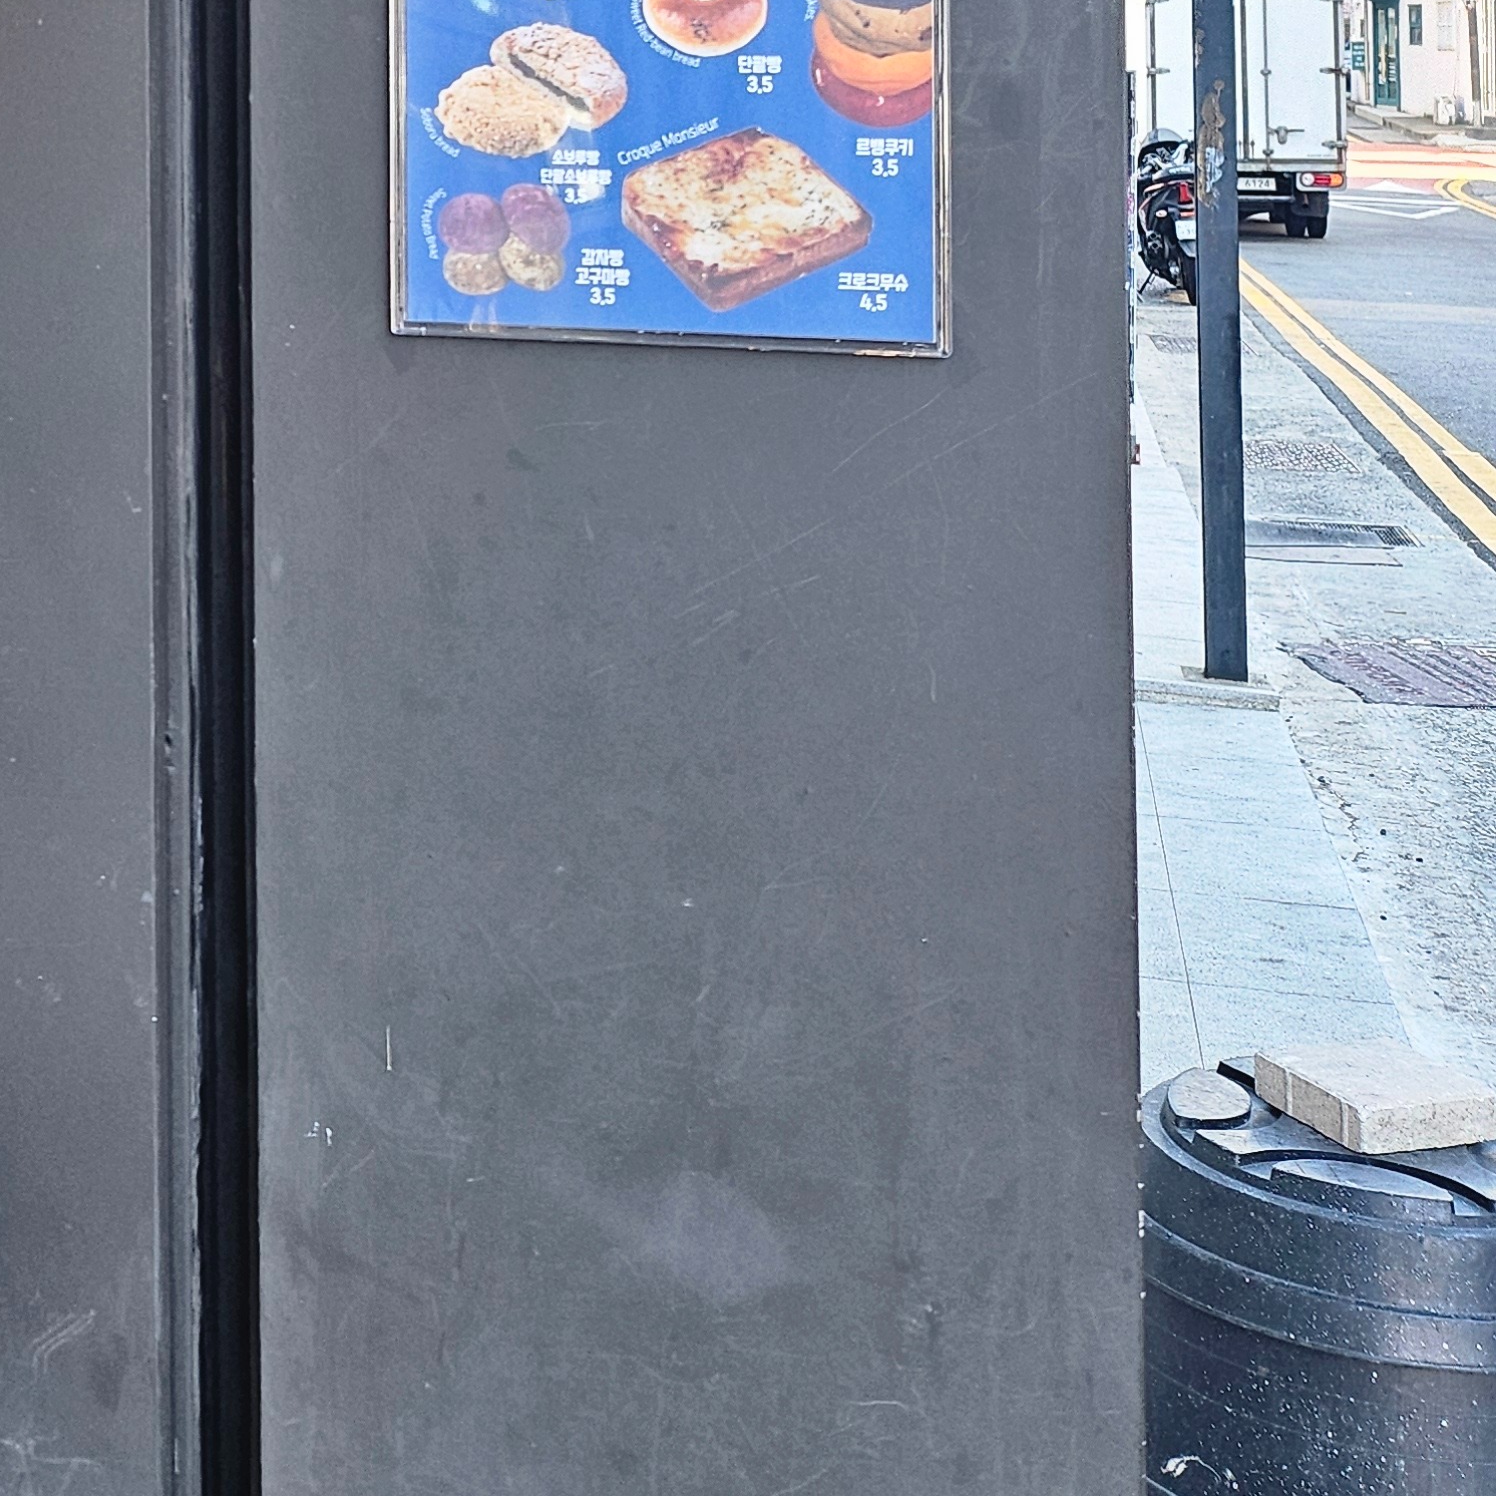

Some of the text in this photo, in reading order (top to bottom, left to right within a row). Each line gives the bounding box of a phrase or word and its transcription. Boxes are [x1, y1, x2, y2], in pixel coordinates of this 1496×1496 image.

[746, 75, 774, 95] 3.5
[617, 116, 719, 166] Croque Monsieur
[855, 137, 914, 157] 르뱅쿠키
[871, 158, 899, 178] 3.5
[575, 267, 631, 287] 고구마빵
[837, 272, 909, 292] 크로크무슈
[589, 287, 617, 307] 3.5
[859, 293, 888, 312] 4.5
